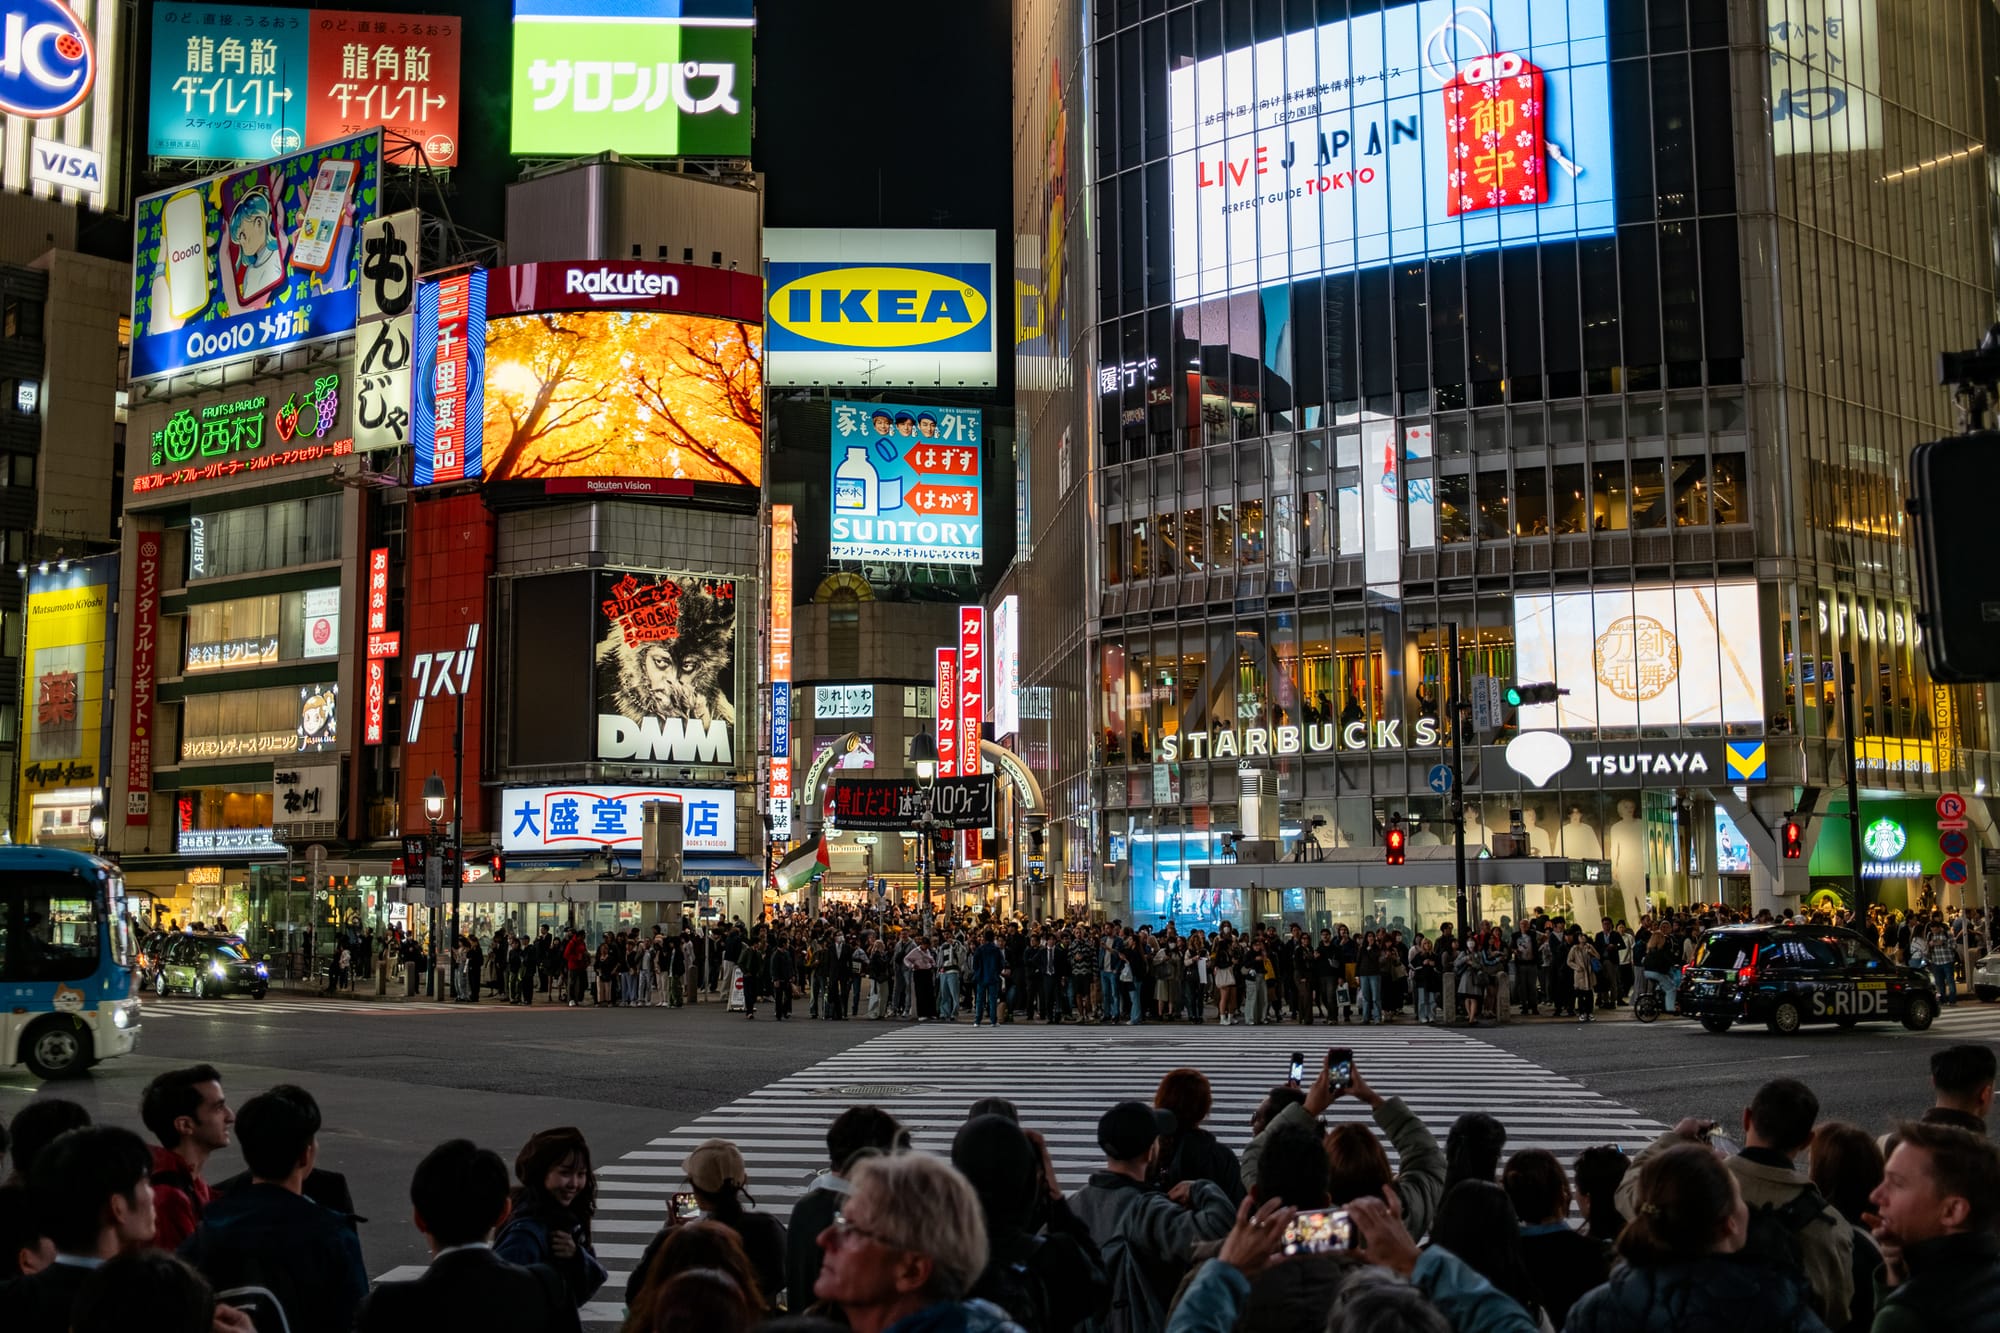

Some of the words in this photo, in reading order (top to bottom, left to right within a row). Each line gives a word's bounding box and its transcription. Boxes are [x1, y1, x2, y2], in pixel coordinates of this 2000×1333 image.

[187, 36, 278, 75] 龍角散
[342, 43, 431, 82] 龍角散
[172, 76, 293, 116] ダイレクト
[328, 83, 447, 122] ダイレクト
[527, 59, 741, 114] サロンパス
[185, 118, 233, 129] スティック
[273, 136, 299, 149] 生薬
[427, 143, 453, 154] 生薬
[1199, 146, 1268, 189] LIVE
[1281, 115, 1419, 170] JAPAN
[1470, 97, 1516, 187] 御守
[35, 147, 99, 182] VISA
[1222, 196, 1265, 215] PERFECT
[1268, 188, 1302, 204] GUIDE
[1306, 168, 1375, 196] TOKYO
[172, 243, 201, 263] Qoo10
[566, 268, 680, 300] Rakuten
[788, 288, 973, 324] IKEA
[186, 322, 255, 358] Qoo10
[259, 304, 312, 344] メガポ
[358, 221, 415, 441] もんじゃ
[433, 285, 460, 470] 三千里薬品
[201, 412, 265, 457] 西村
[915, 448, 973, 472] はずす
[587, 480, 623, 492] Rakuten
[624, 480, 652, 491] Vision
[915, 489, 974, 512] はがす
[775, 510, 789, 619] クスリのことなら
[32, 602, 75, 615] Matsumoto
[370, 553, 386, 629] お好み焼
[134, 559, 156, 724] ウィンターフルーツギフト
[1607, 630, 1665, 658] 刀剣
[940, 661, 950, 680] BIG
[962, 619, 981, 708] カラオケ
[1608, 663, 1666, 690] 乱舞
[38, 670, 79, 726] 薬
[407, 623, 481, 743] クスリ
[831, 688, 873, 701] れいわ
[940, 679, 950, 709] ECHO
[367, 664, 382, 741] もんじゃ焼
[775, 686, 787, 754] 大盛堂商事ビル
[817, 703, 873, 717] クリニック
[183, 735, 298, 757] ジャスミンレディースクリニック
[597, 713, 732, 763] DMM
[939, 717, 954, 775] カラオ
[965, 717, 977, 739] BIG
[1161, 717, 1438, 761] STARBUCKS
[965, 740, 977, 774] ECHO
[1586, 752, 1709, 775] TSUTAYA
[771, 766, 789, 797] 焼肉
[513, 797, 720, 838] 大盛堂店
[898, 783, 990, 817] 迷ハロウィーン
[215, 834, 275, 848] フルーツパーラ
[1812, 989, 1889, 1016] S.RIDE
